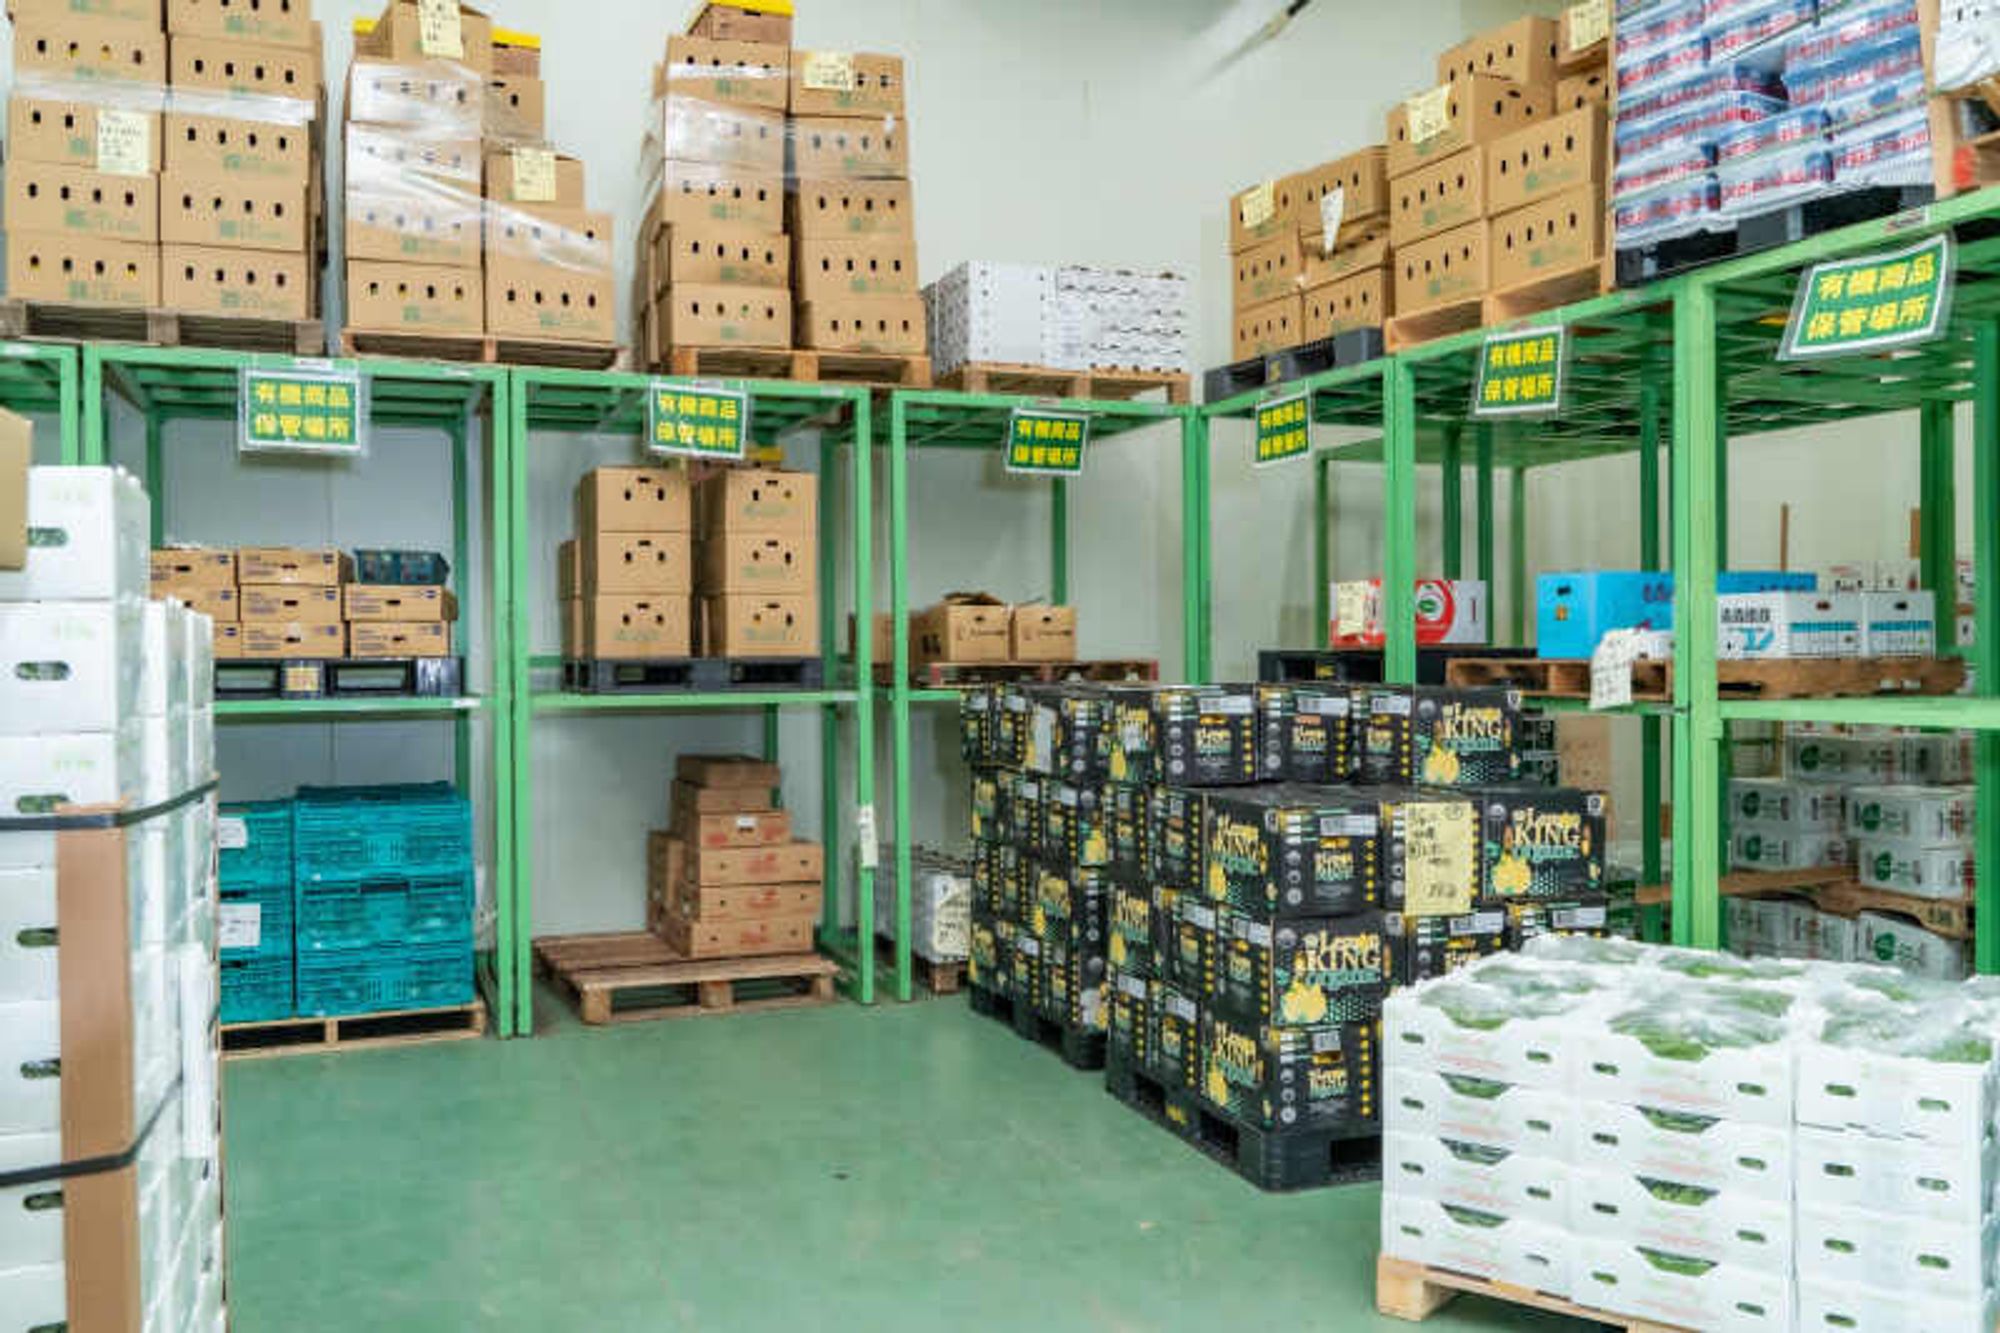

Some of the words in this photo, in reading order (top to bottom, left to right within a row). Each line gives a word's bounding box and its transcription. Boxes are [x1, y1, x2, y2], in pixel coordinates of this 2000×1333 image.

[1817, 253, 1936, 300] 有機商品
[1807, 294, 1930, 341] 保管場所
[1443, 717, 1501, 739] KING
[1514, 821, 1581, 846] KING
[1306, 944, 1381, 971] KING
